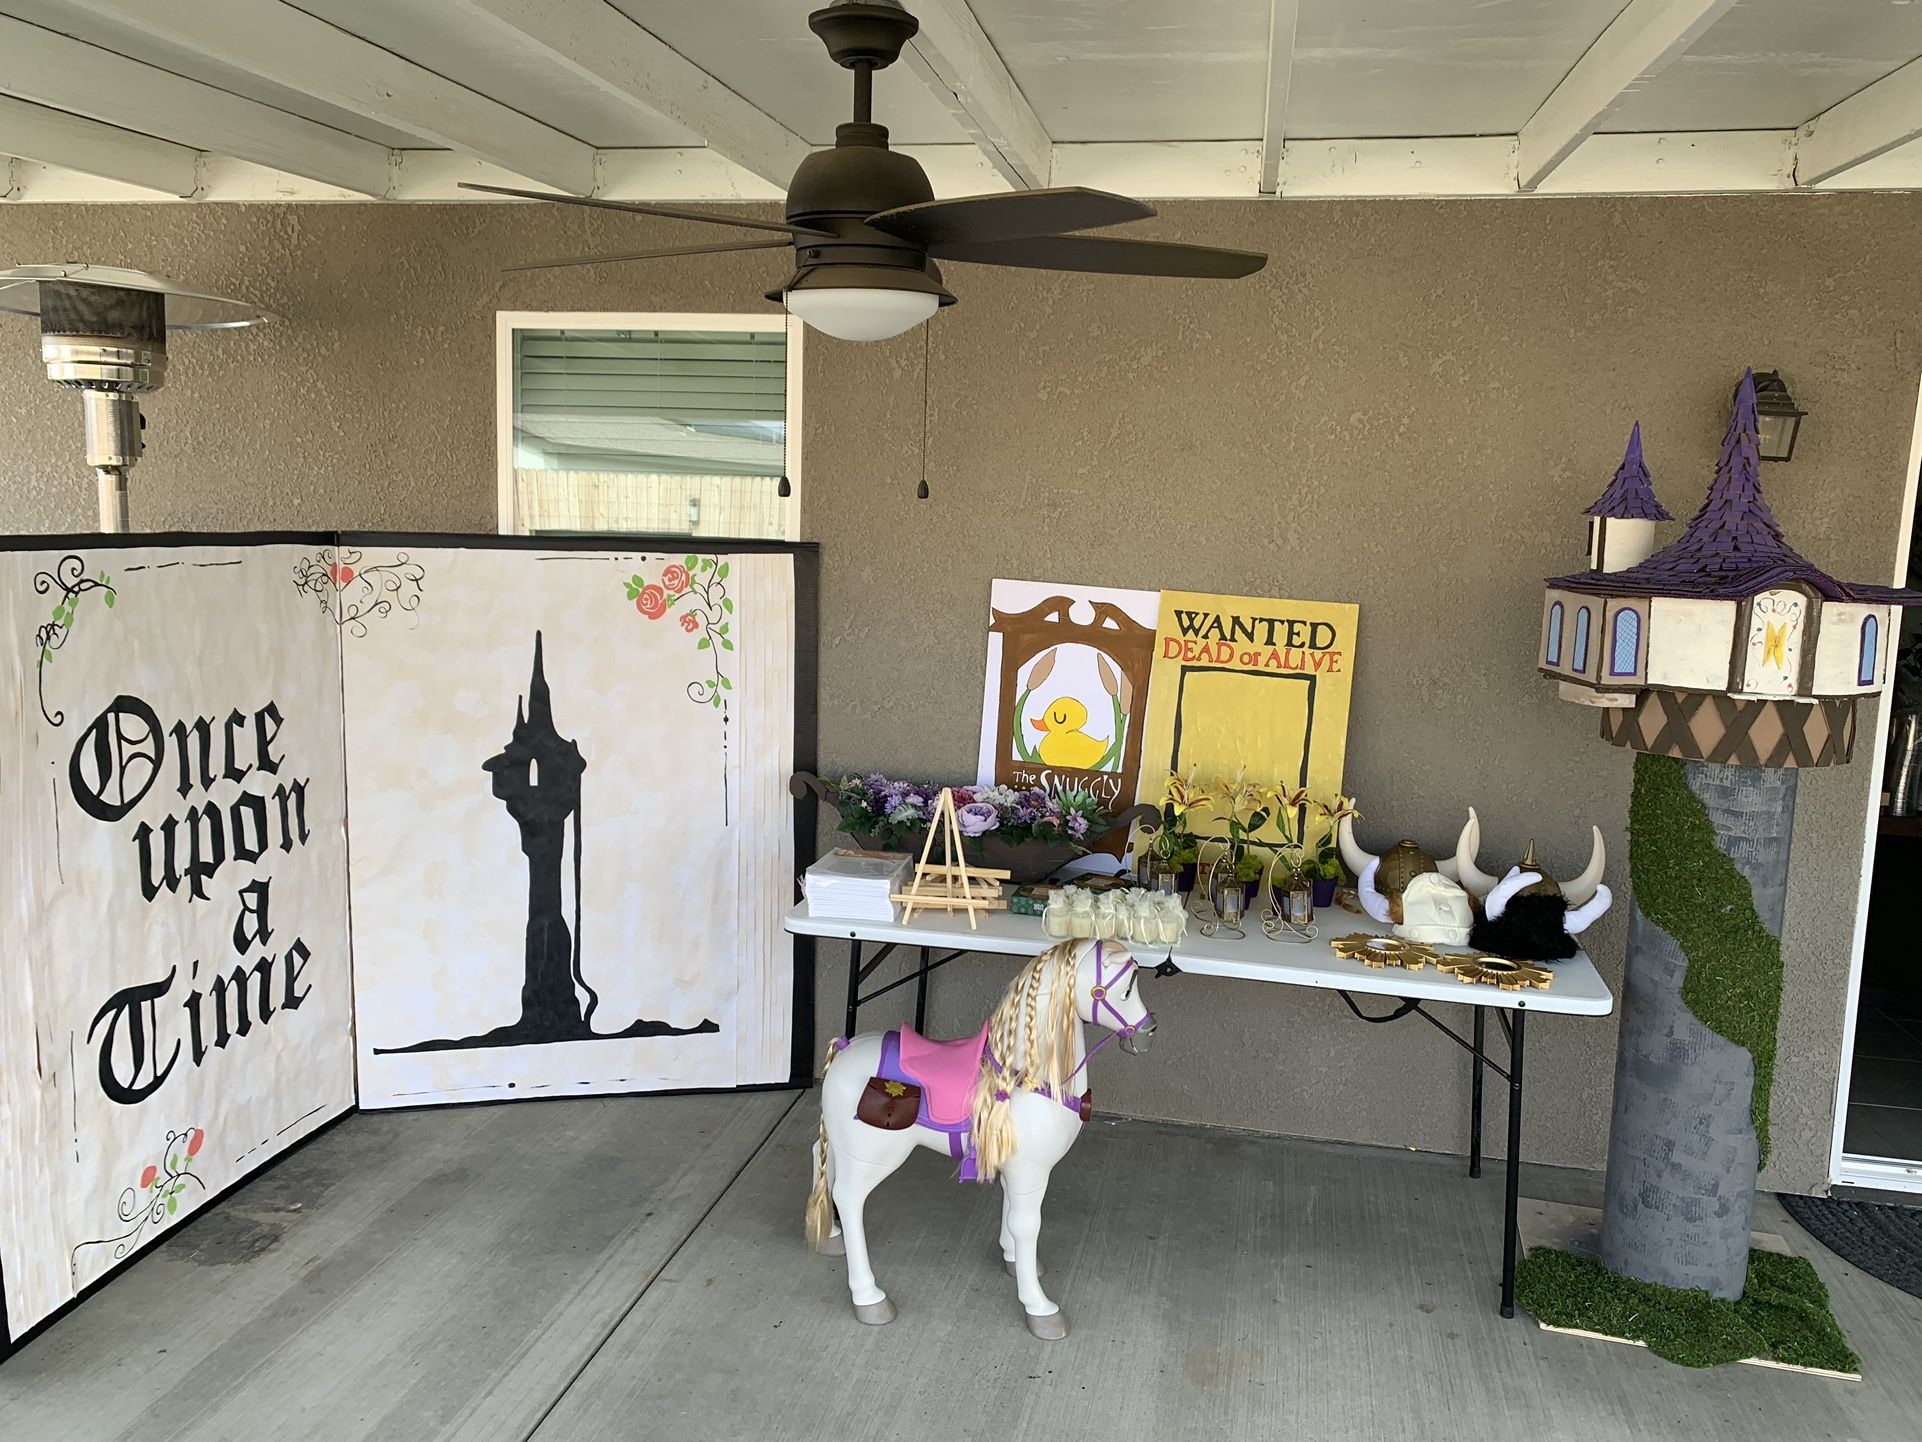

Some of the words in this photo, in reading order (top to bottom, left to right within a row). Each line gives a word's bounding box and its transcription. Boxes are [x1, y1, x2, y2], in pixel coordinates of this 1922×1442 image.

[1162, 637, 1235, 664] DEAD
[1173, 609, 1337, 651] WANTED
[68, 694, 286, 823] Once
[1013, 769, 1037, 785] The
[131, 777, 311, 904] upon
[232, 875, 275, 956] a
[86, 936, 313, 1105] Time
